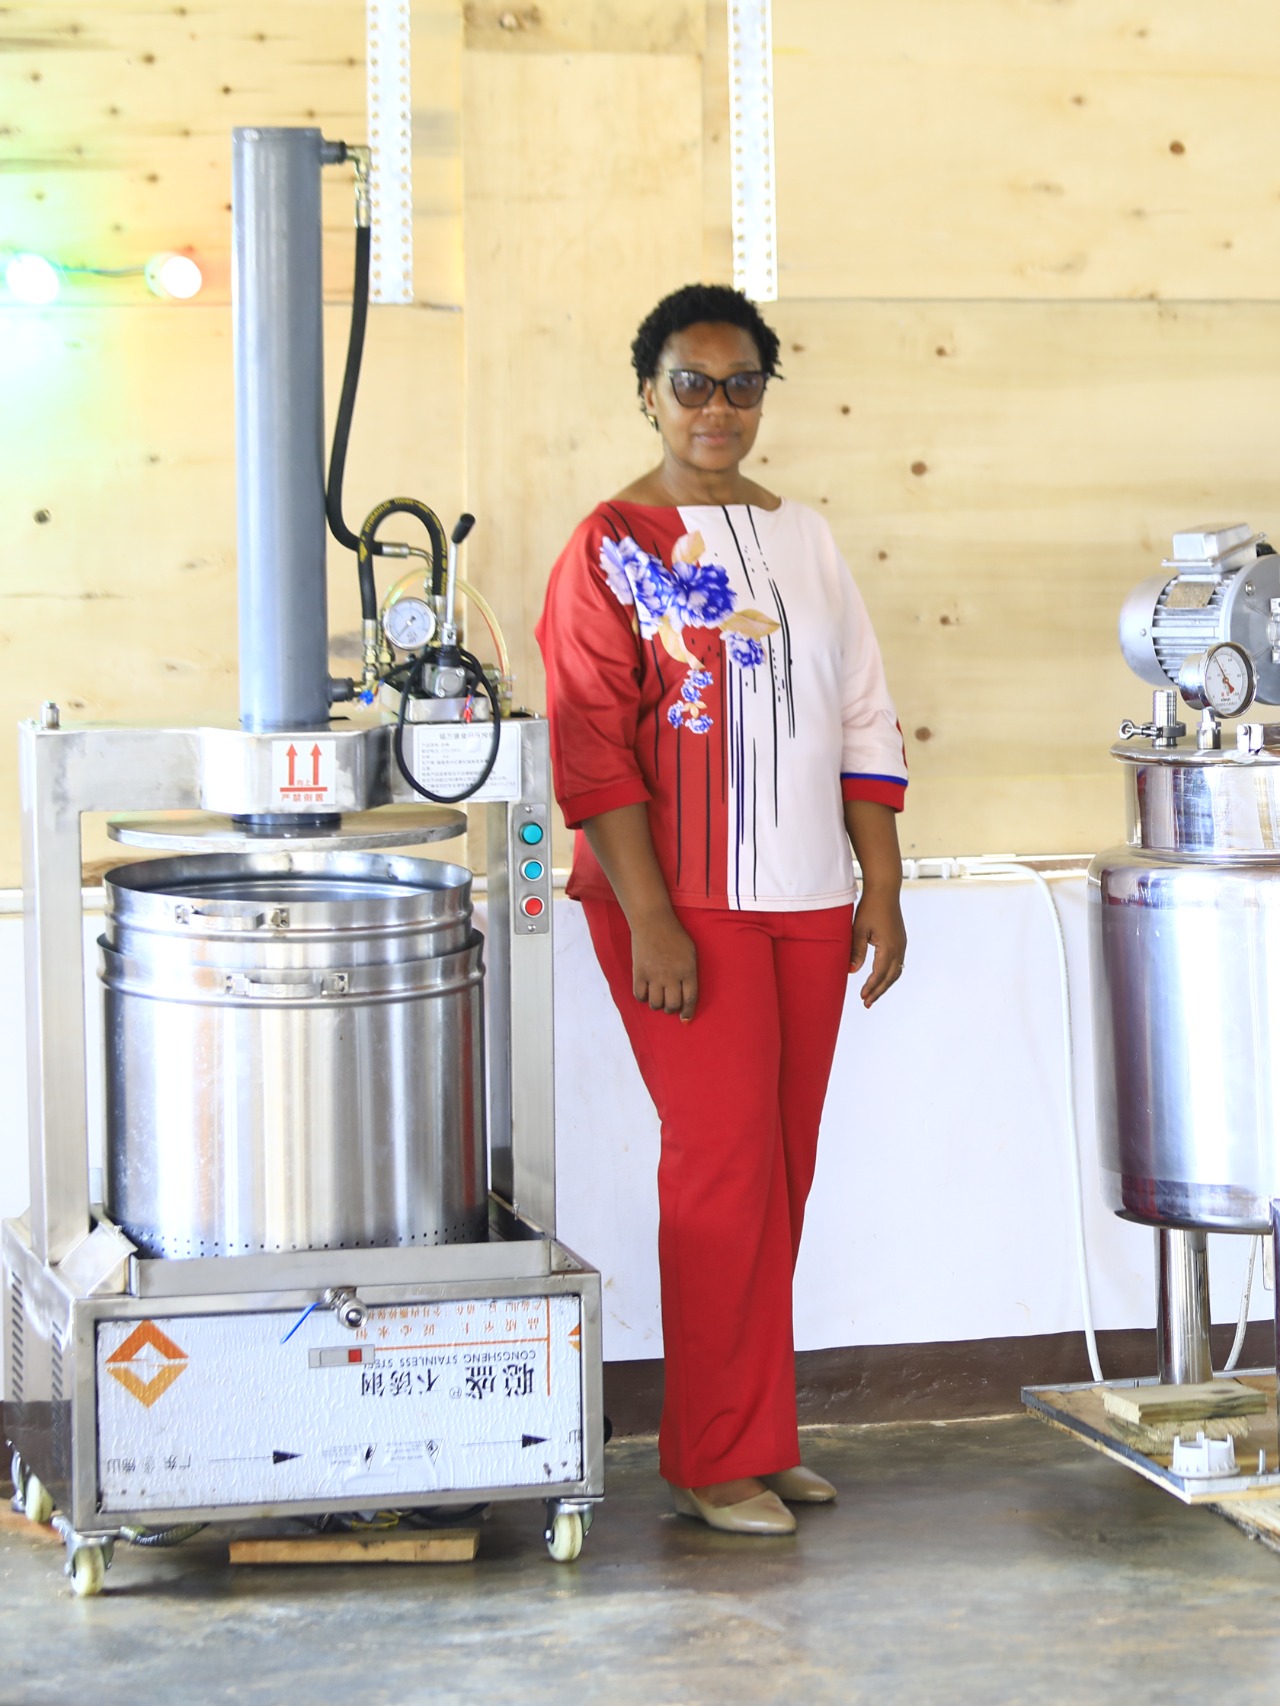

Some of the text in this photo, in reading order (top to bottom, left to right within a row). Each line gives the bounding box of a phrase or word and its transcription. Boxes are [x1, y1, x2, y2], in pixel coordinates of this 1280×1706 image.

[399, 1354, 458, 1367] STAINLESS
[463, 1349, 537, 1363] CONGSHENG
[360, 1368, 440, 1398] 不锈钢
